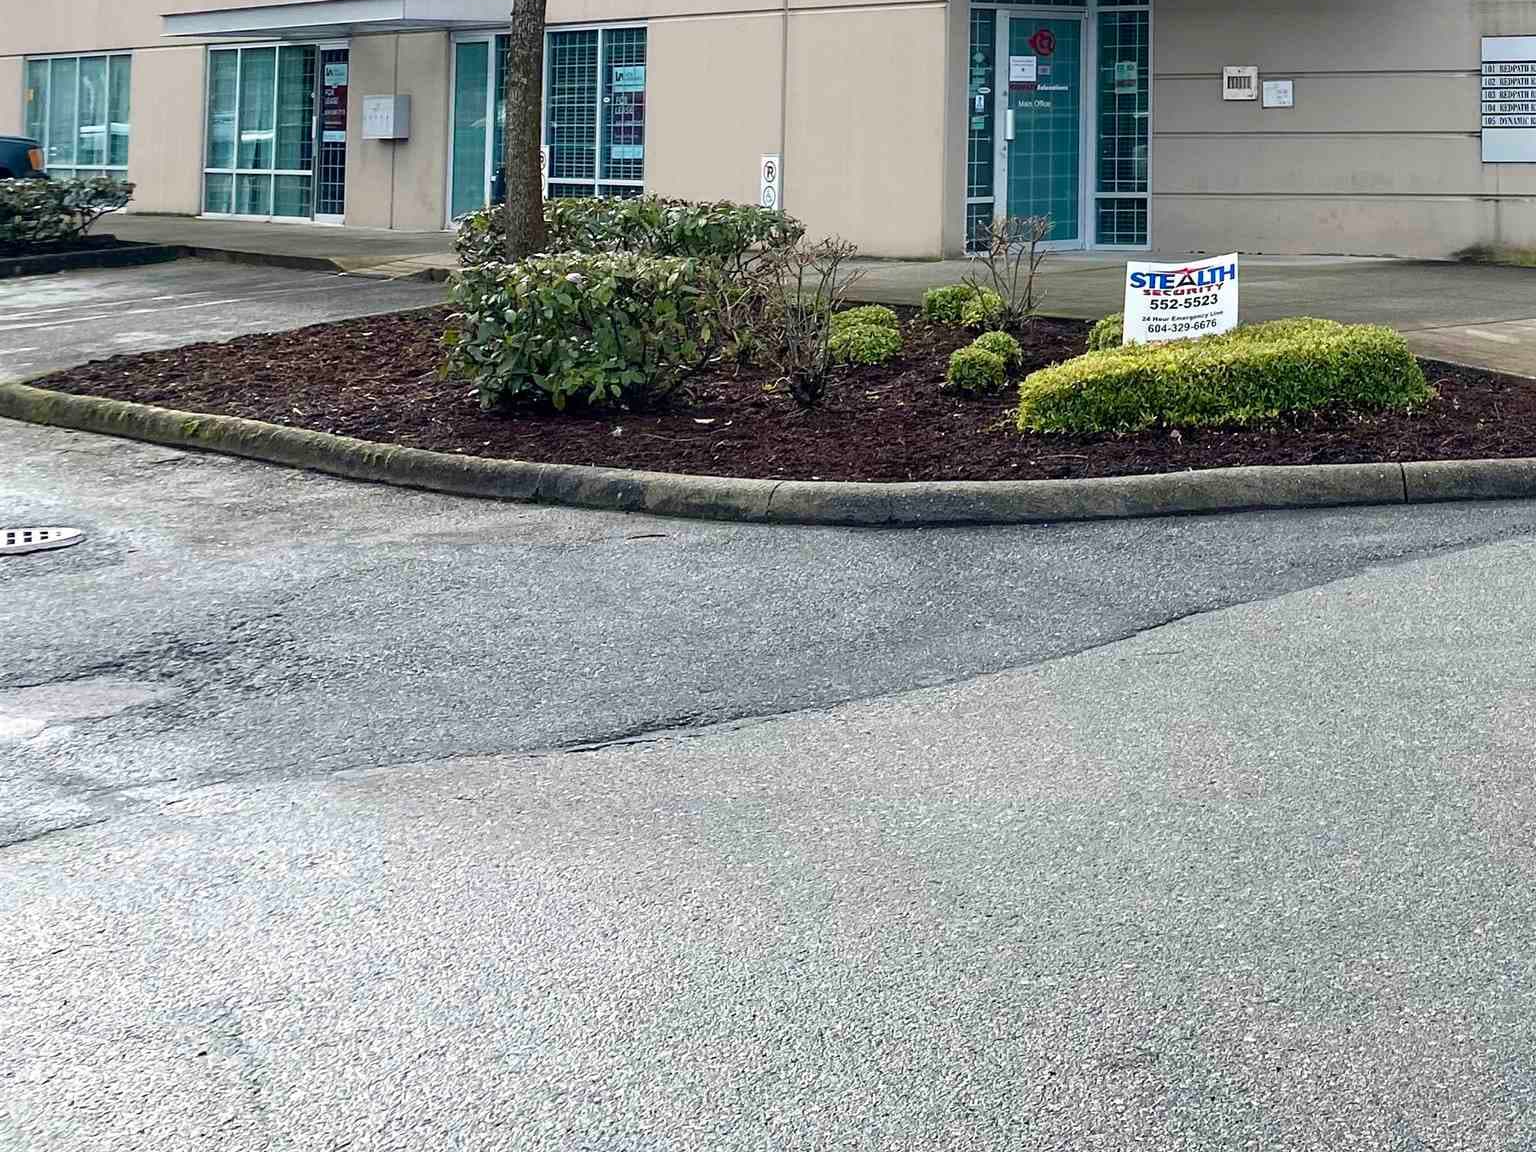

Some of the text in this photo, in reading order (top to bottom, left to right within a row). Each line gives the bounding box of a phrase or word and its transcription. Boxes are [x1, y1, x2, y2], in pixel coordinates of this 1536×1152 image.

[1499, 64, 1529, 73] REDPATH
[1499, 77, 1529, 86] REDPATH
[1499, 90, 1529, 99] REDPATH
[1499, 103, 1529, 112] REDPATH
[1499, 116, 1529, 125] DYNAMIC
[1130, 263, 1235, 289] STEALTH
[1143, 282, 1224, 296] SECURITY
[1150, 294, 1218, 310] 552-5523
[1148, 319, 1217, 333] 604-329-6676
